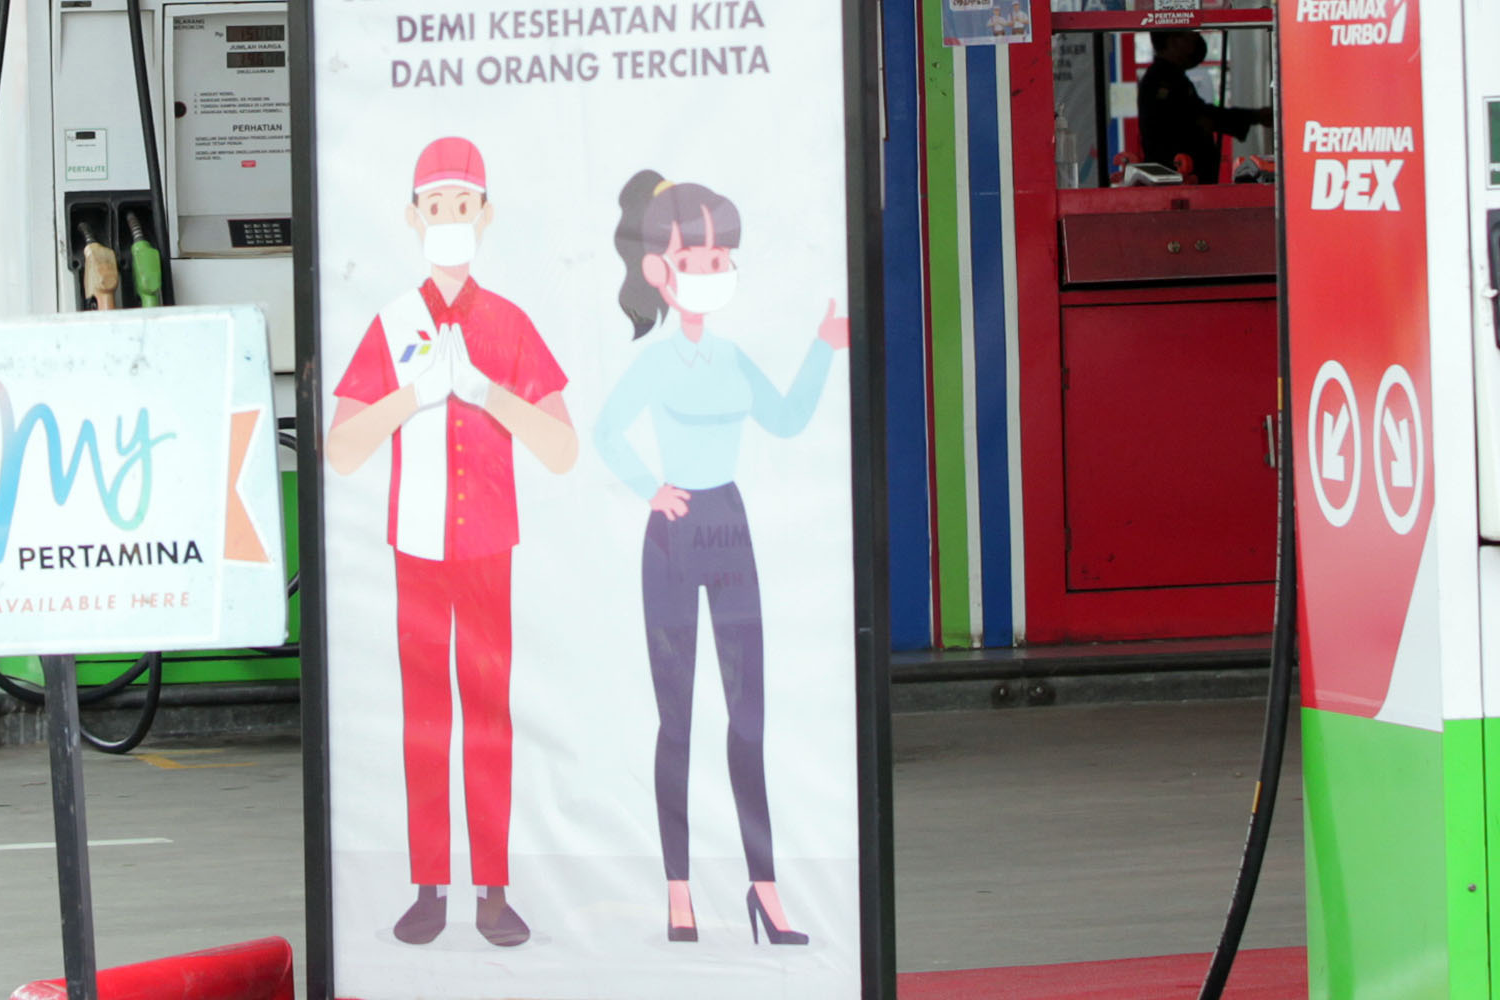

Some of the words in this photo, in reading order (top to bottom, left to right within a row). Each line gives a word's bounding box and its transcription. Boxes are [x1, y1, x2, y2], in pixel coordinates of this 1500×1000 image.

[397, 14, 475, 44] DEMI
[489, 4, 678, 40] KESEHATAN
[690, 0, 765, 31] KITA
[1155, 12, 1194, 20] PERTAMINA
[1331, 23, 1387, 46] TURBO
[392, 57, 463, 88] DAN
[476, 52, 600, 85] ORANG
[613, 46, 771, 79] TERCINTA
[233, 124, 282, 132] PERHATIAN
[1303, 121, 1414, 152] PERTAMINA
[67, 165, 105, 174] PERTALITE
[1310, 159, 1404, 211] DEX
[18, 540, 204, 570] PERTAMINA
[131, 591, 190, 608] HERE
